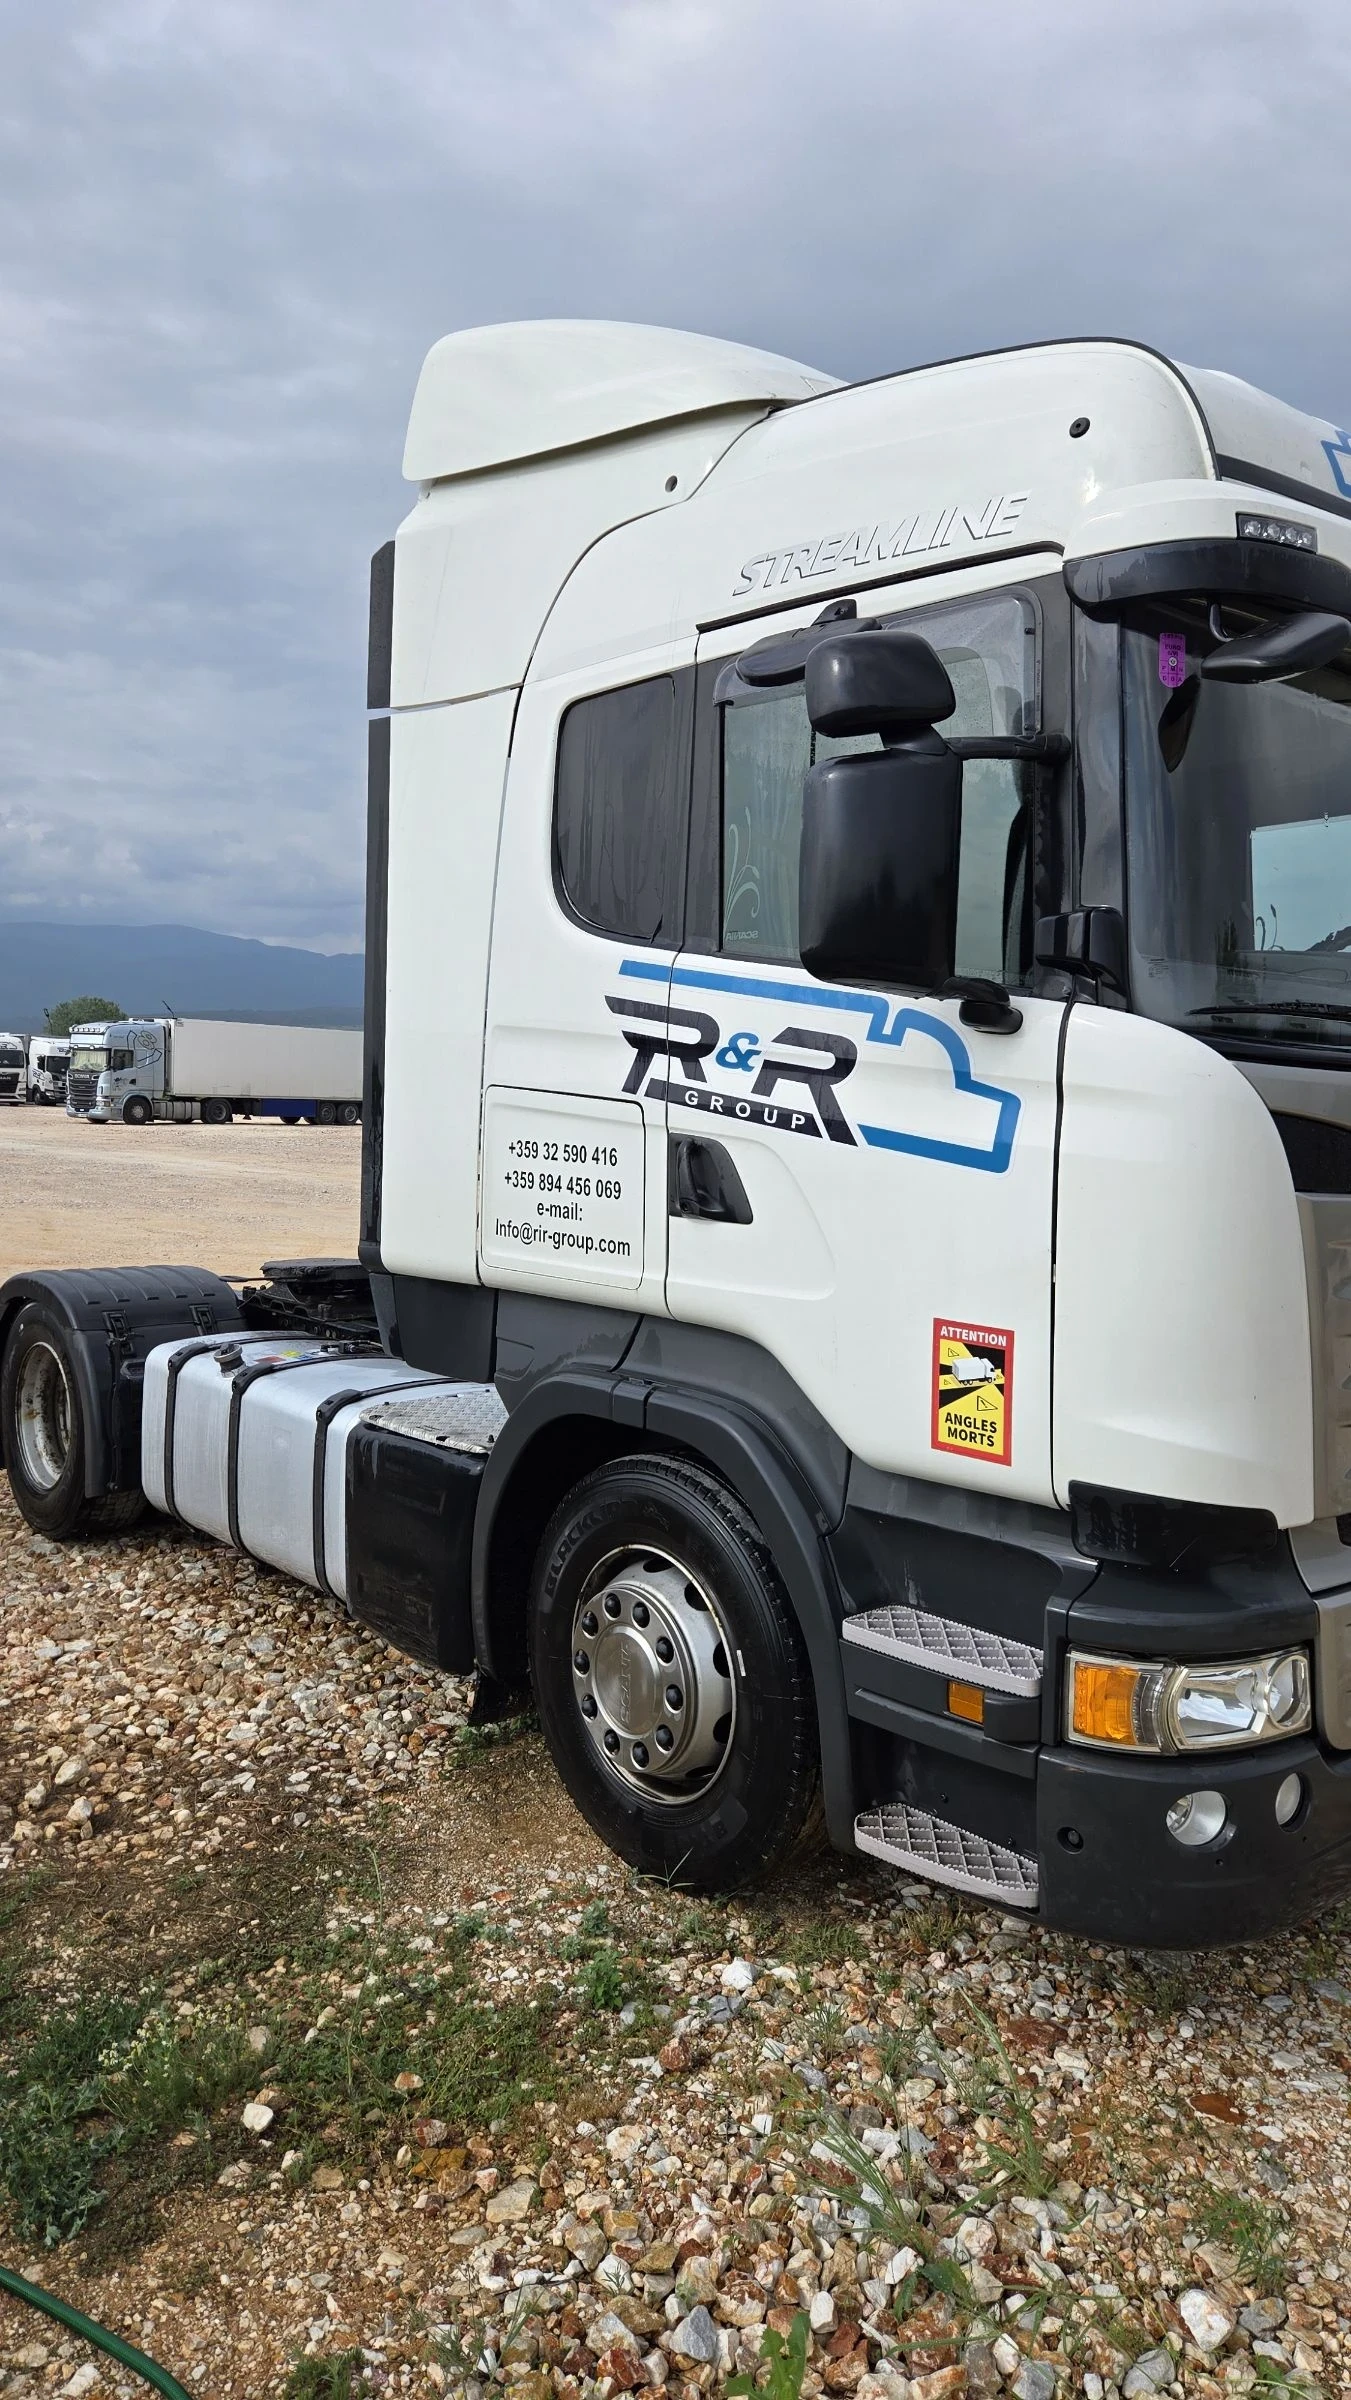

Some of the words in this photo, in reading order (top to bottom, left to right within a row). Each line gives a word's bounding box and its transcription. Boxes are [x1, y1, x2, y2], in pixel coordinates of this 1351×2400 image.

[733, 490, 1032, 597] STREAMLINE
[684, 1090, 806, 1129] GROUP
[508, 1139, 539, 1159] +359
[543, 1142, 558, 1161] 32
[563, 1143, 587, 1163] 590
[591, 1146, 618, 1167] 416
[504, 1170, 535, 1189] +359
[538, 1173, 562, 1192] 894
[566, 1176, 591, 1196] 456
[595, 1179, 621, 1200] 069
[536, 1202, 583, 1221] e-mail:
[495, 1218, 631, 1256] Info@rir-group.com
[940, 1325, 1007, 1347] ATTENTION
[944, 1411, 997, 1434] ANGLES
[947, 1425, 995, 1448] MORTS
